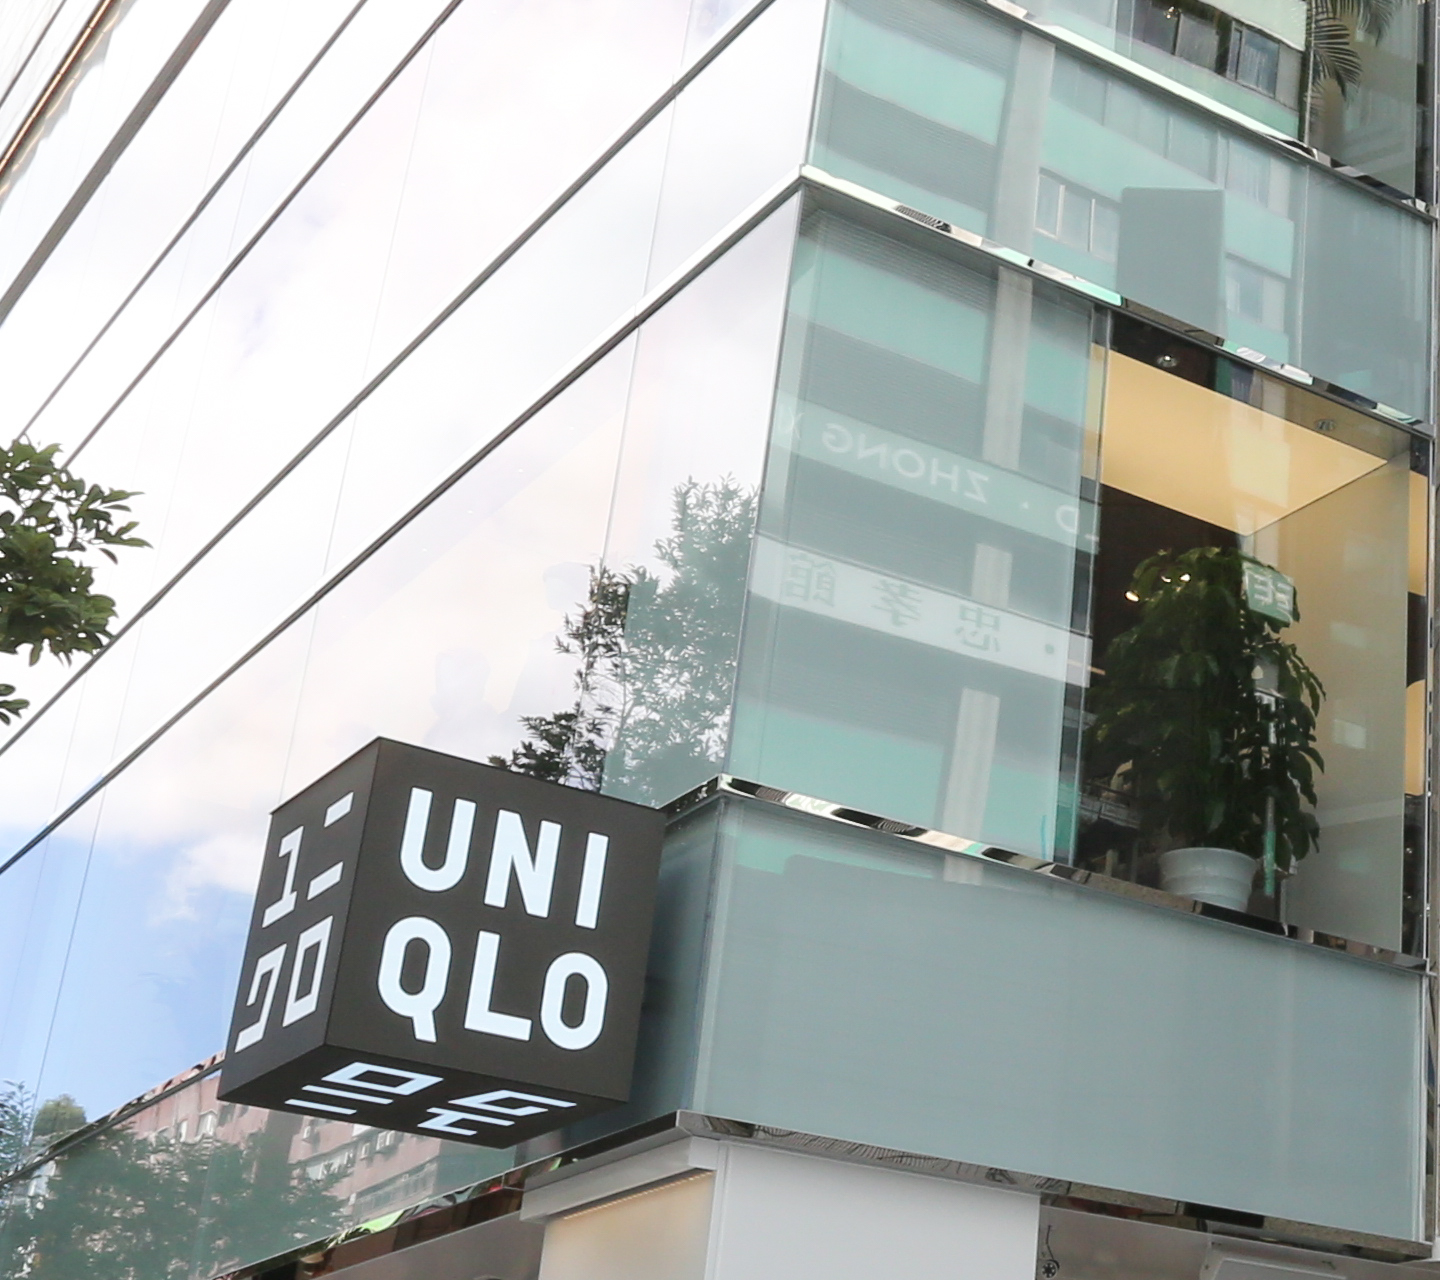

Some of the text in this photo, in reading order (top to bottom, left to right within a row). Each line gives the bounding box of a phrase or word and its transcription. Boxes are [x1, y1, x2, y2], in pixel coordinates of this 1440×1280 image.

[262, 791, 354, 929] ユニ
[399, 786, 610, 930] UNI
[377, 916, 610, 1051] QLO
